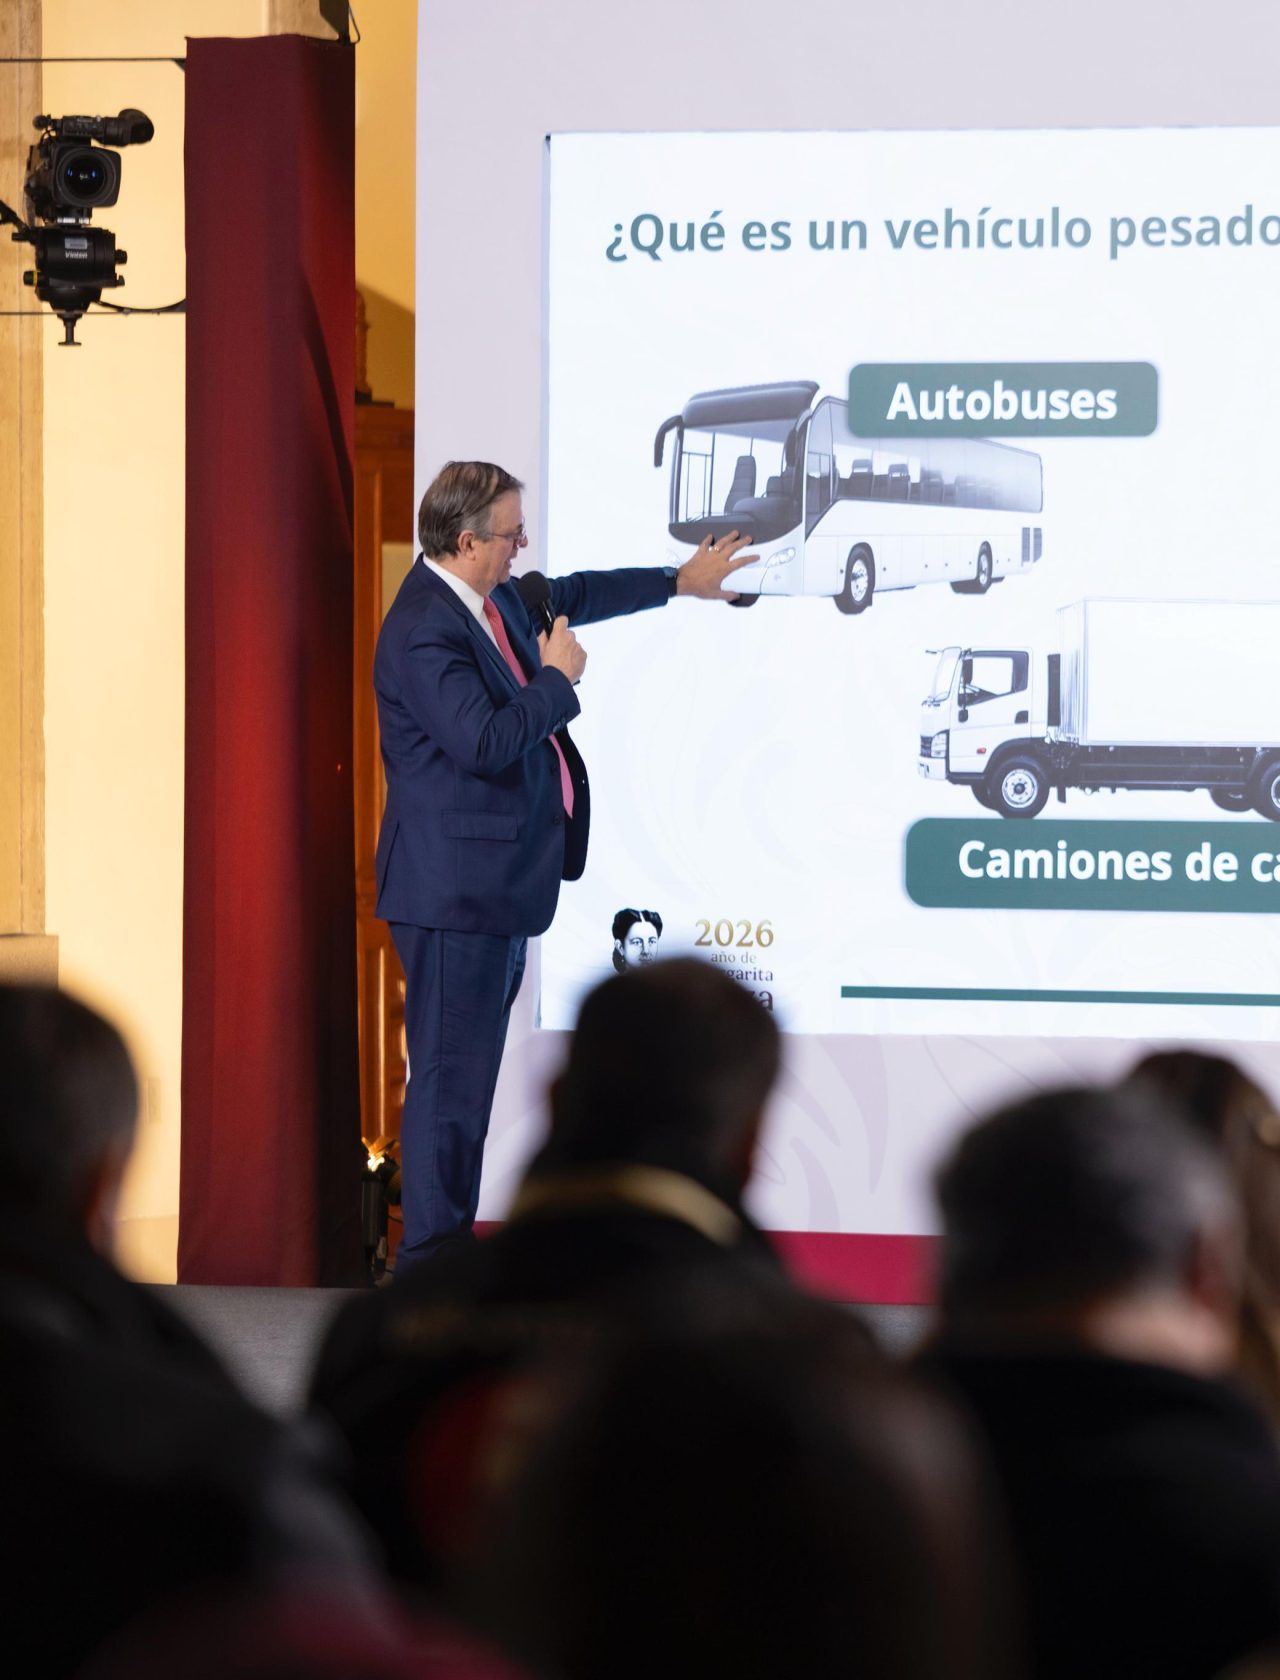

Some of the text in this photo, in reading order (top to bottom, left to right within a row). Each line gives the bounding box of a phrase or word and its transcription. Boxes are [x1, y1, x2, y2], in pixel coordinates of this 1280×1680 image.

[605, 209, 726, 264] ¿Qué
[741, 220, 792, 252] es
[808, 219, 868, 251] un
[883, 206, 1092, 250] vehículo
[886, 379, 1118, 421] Autobuses
[958, 839, 1173, 881] Camiones
[1185, 841, 1239, 882] de
[694, 919, 774, 948] 2026
[711, 951, 757, 964] año de
